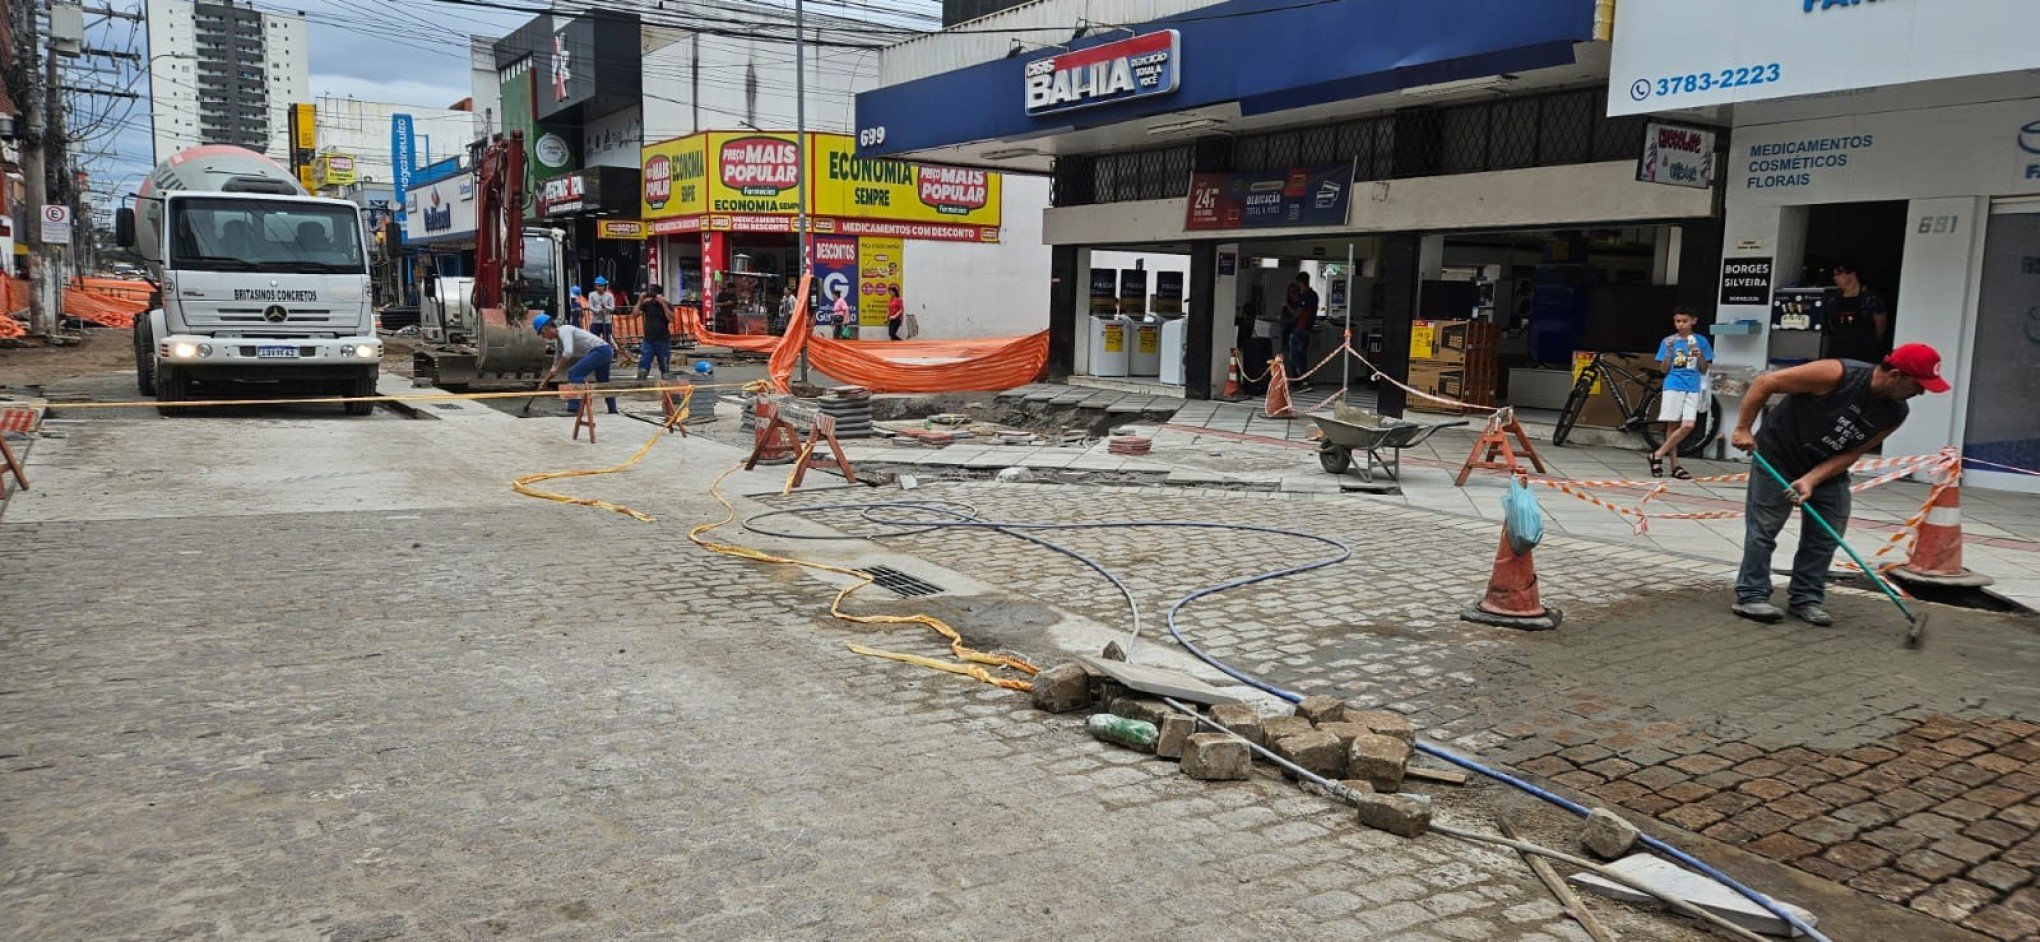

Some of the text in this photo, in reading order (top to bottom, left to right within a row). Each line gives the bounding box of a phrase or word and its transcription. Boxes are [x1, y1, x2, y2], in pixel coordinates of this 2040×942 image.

[1027, 56, 1135, 109] BAHIA
[1656, 63, 1780, 96] 3783-2223
[860, 126, 886, 147] 699
[1750, 134, 1873, 157] MEDICAMENTOS
[745, 144, 797, 164] MAIS
[1748, 152, 1848, 173] COSMÉTICOS
[723, 163, 798, 182] POPULAR
[829, 151, 914, 186] ECONOMIA
[941, 169, 985, 186] MAIS
[1747, 173, 1810, 189] FLORAIS
[855, 186, 891, 207] SEMPRE
[921, 182, 985, 204] POPULAR
[1246, 191, 1281, 205] DEDICAÇÃO
[714, 199, 779, 211] ECONOMIA
[842, 221, 911, 236] MEDICAMENTOS
[911, 225, 932, 237] COM
[932, 226, 975, 239] DESCONTO
[1917, 214, 1959, 234] 691
[816, 242, 856, 261] DESCONTOS
[1724, 263, 1770, 274] BORGES
[823, 272, 850, 302] G
[1724, 277, 1768, 287] SILVEIRA
[234, 288, 317, 302] BRITASINOS CONCRETOS
